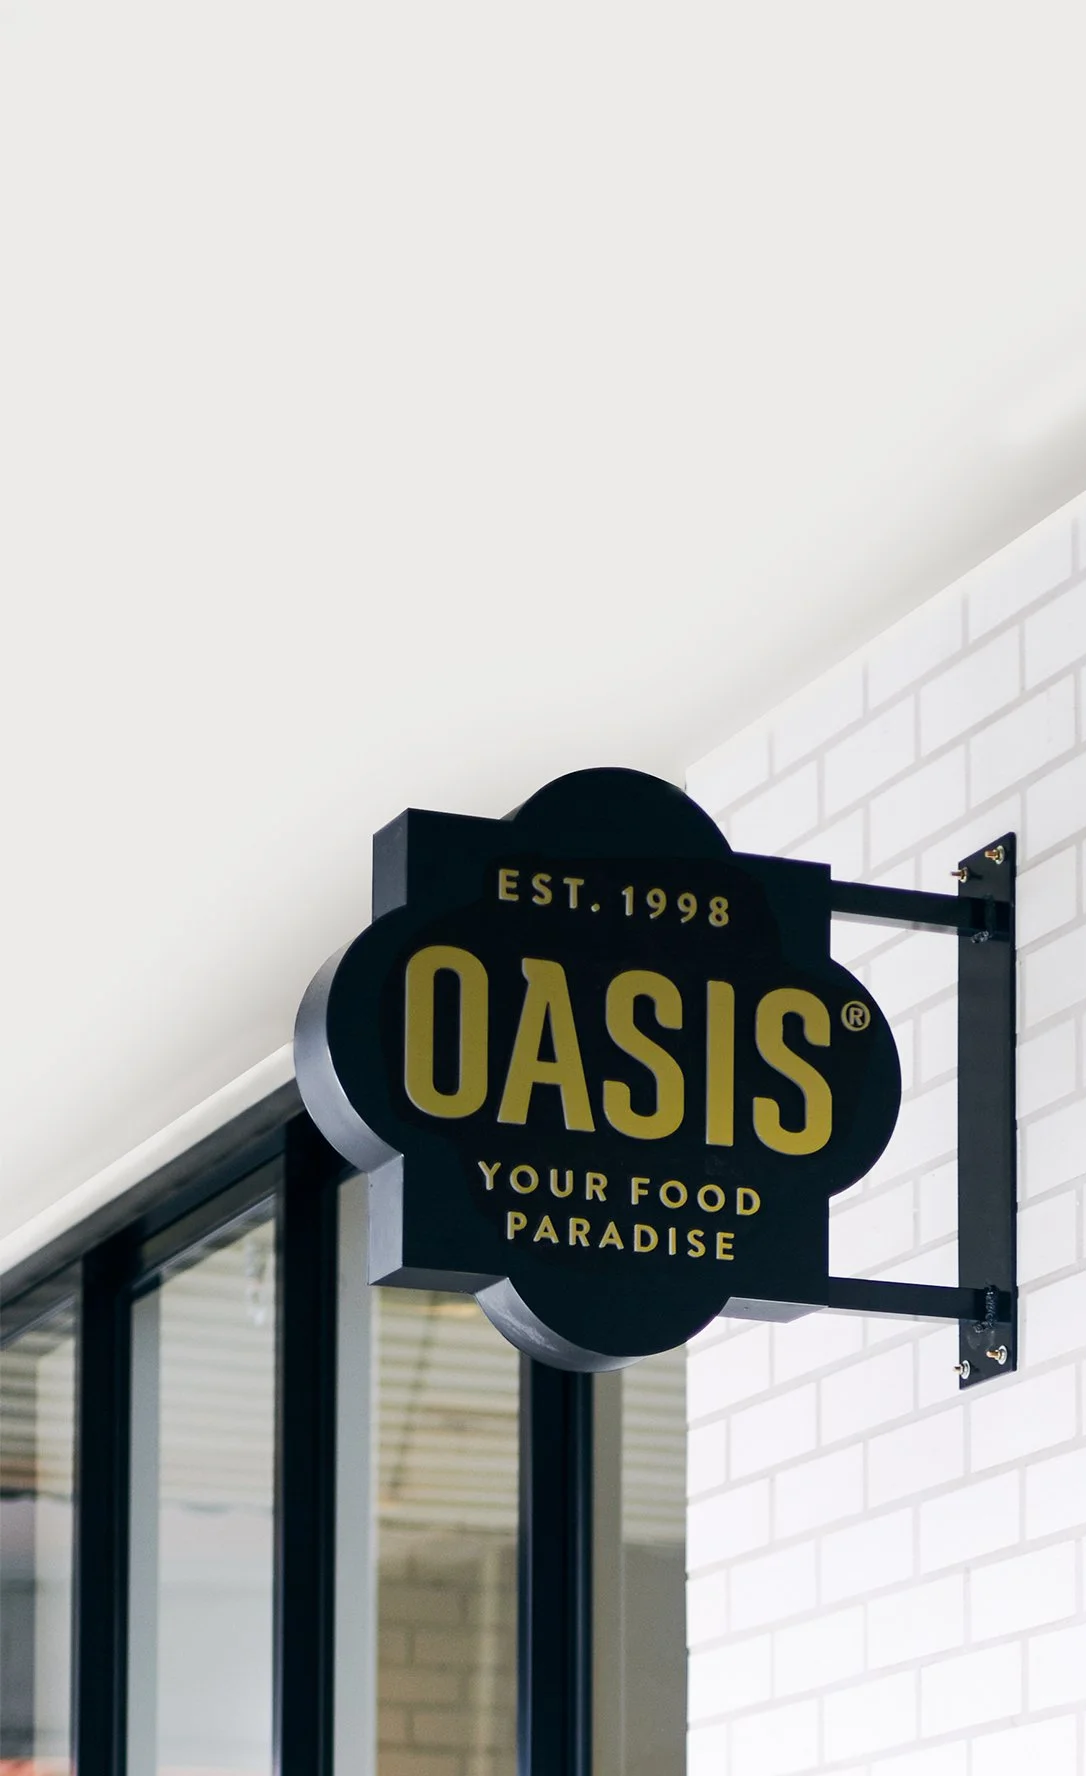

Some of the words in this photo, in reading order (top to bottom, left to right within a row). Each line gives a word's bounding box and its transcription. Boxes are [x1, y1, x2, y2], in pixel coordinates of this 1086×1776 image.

[498, 869, 601, 914] EST.
[621, 886, 730, 928] 1998
[477, 1160, 609, 1202] YOUR
[630, 1176, 762, 1217] FOOD
[506, 1211, 736, 1261] PARADISE
